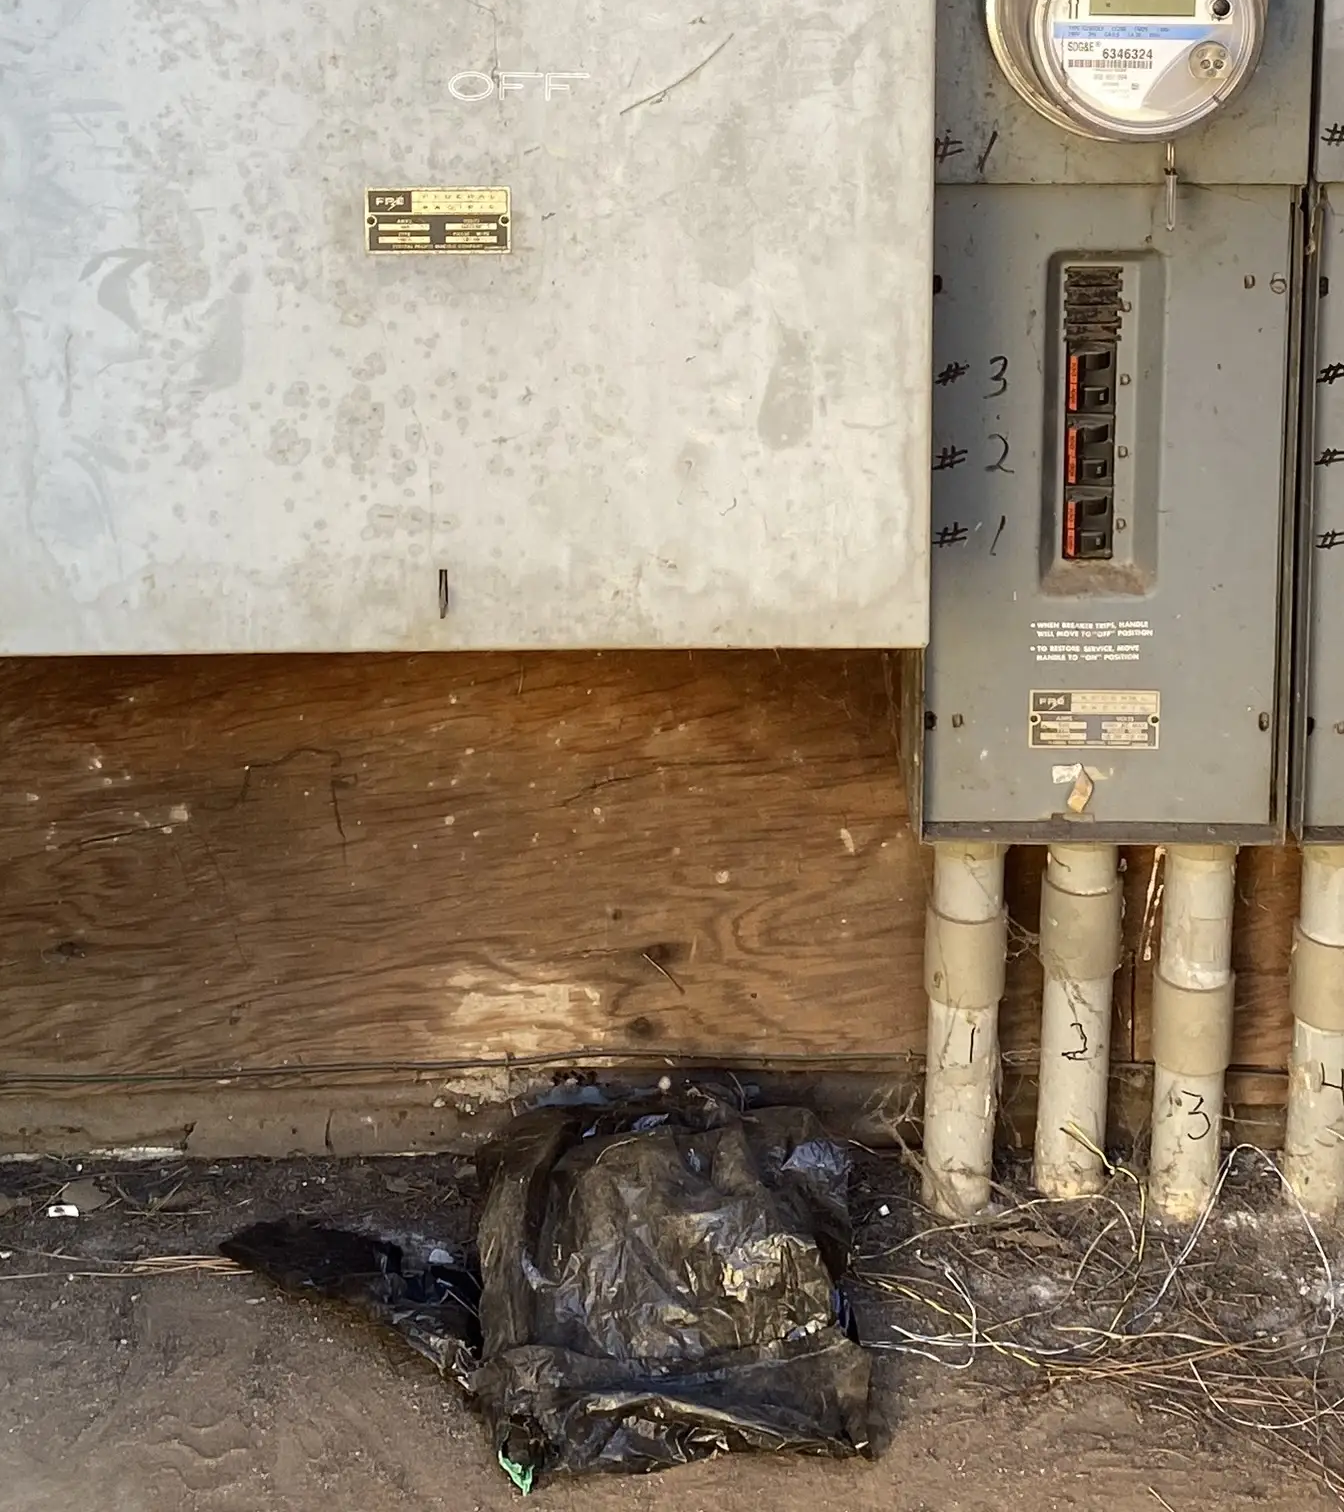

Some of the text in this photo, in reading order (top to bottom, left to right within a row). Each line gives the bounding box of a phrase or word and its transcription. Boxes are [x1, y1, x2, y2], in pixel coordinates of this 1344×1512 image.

[1102, 48, 1154, 60] 6346324
[448, 71, 591, 102] OFF
[934, 354, 1010, 399] #3
[932, 433, 1015, 475] #2
[932, 515, 1007, 557] #1
[1180, 1089, 1212, 1141] 3
